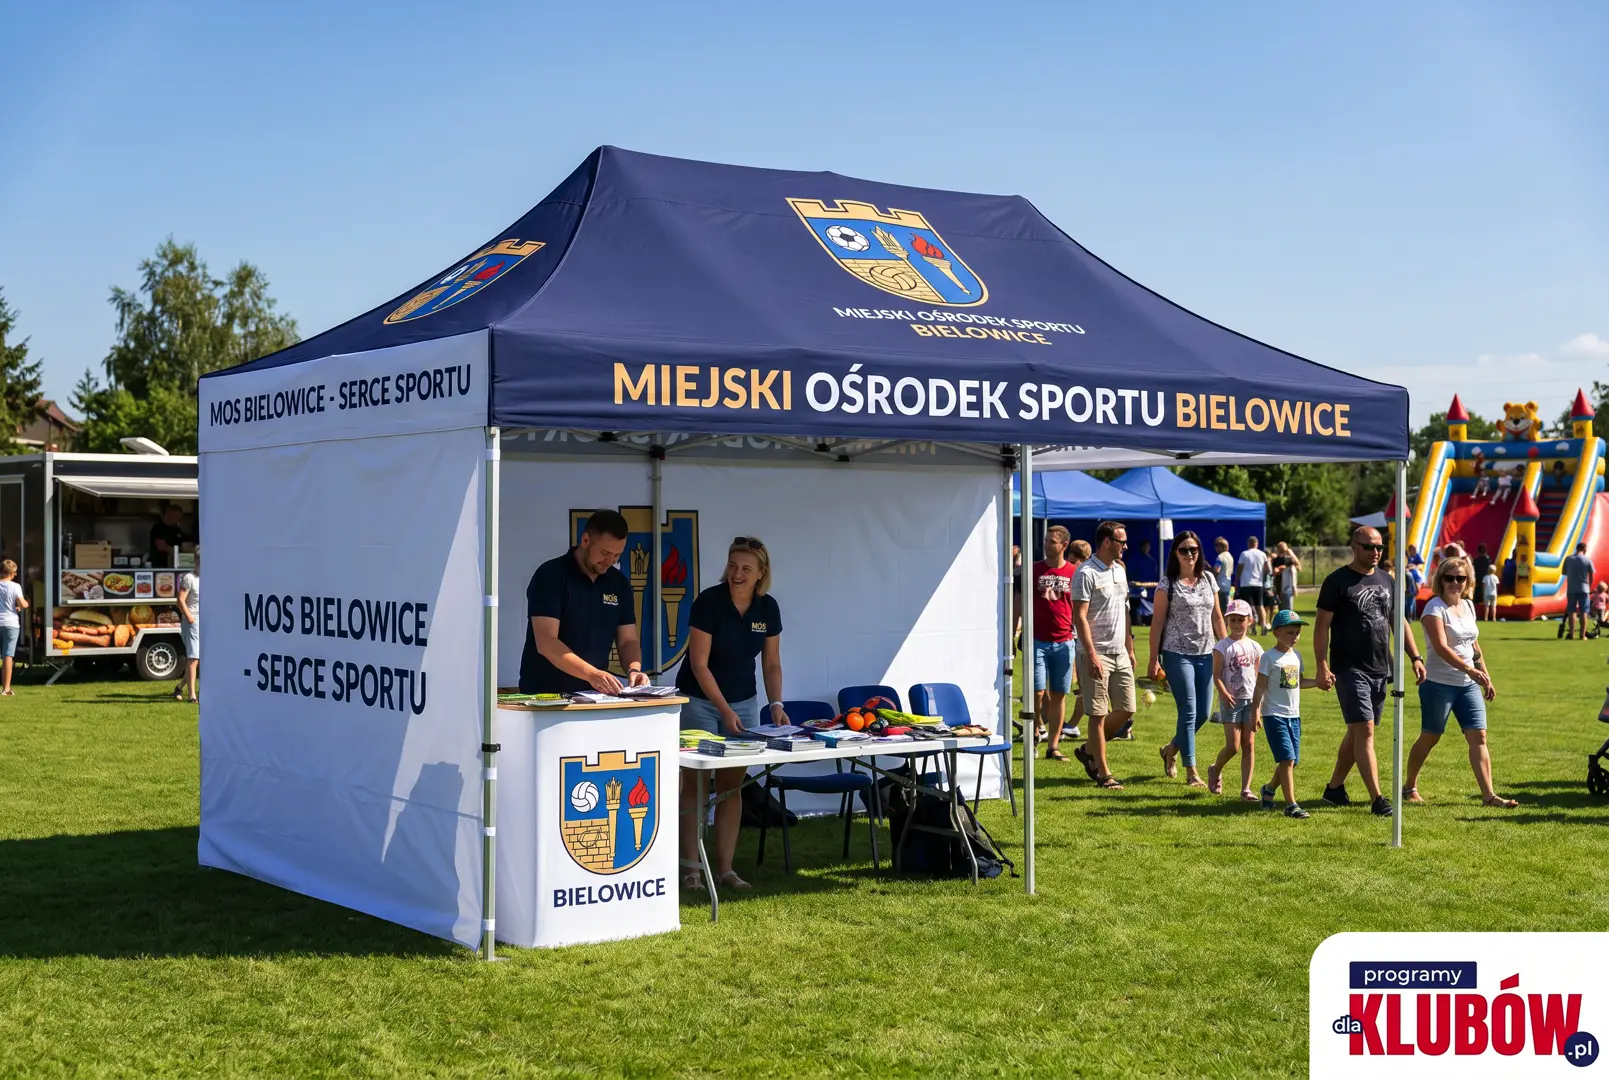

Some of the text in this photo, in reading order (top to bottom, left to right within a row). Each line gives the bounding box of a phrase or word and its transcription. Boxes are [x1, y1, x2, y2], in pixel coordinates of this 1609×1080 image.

[832, 306, 1086, 335] MIEJSKI OŚRODEK SPORTU
[910, 323, 1052, 345] BIELOWICE
[210, 398, 241, 427] MOS
[244, 384, 326, 423] BIELOWICE
[338, 375, 391, 411] SERCE
[394, 363, 472, 404] SPORTU
[613, 362, 1352, 438] MIEJSKI OŚRODEK SPORTU BIELOWICE
[244, 592, 428, 647] MOS BIELOWICE
[256, 652, 326, 700] SERCE
[331, 660, 427, 716] SPORTU
[553, 877, 666, 908] BIELOWICE
